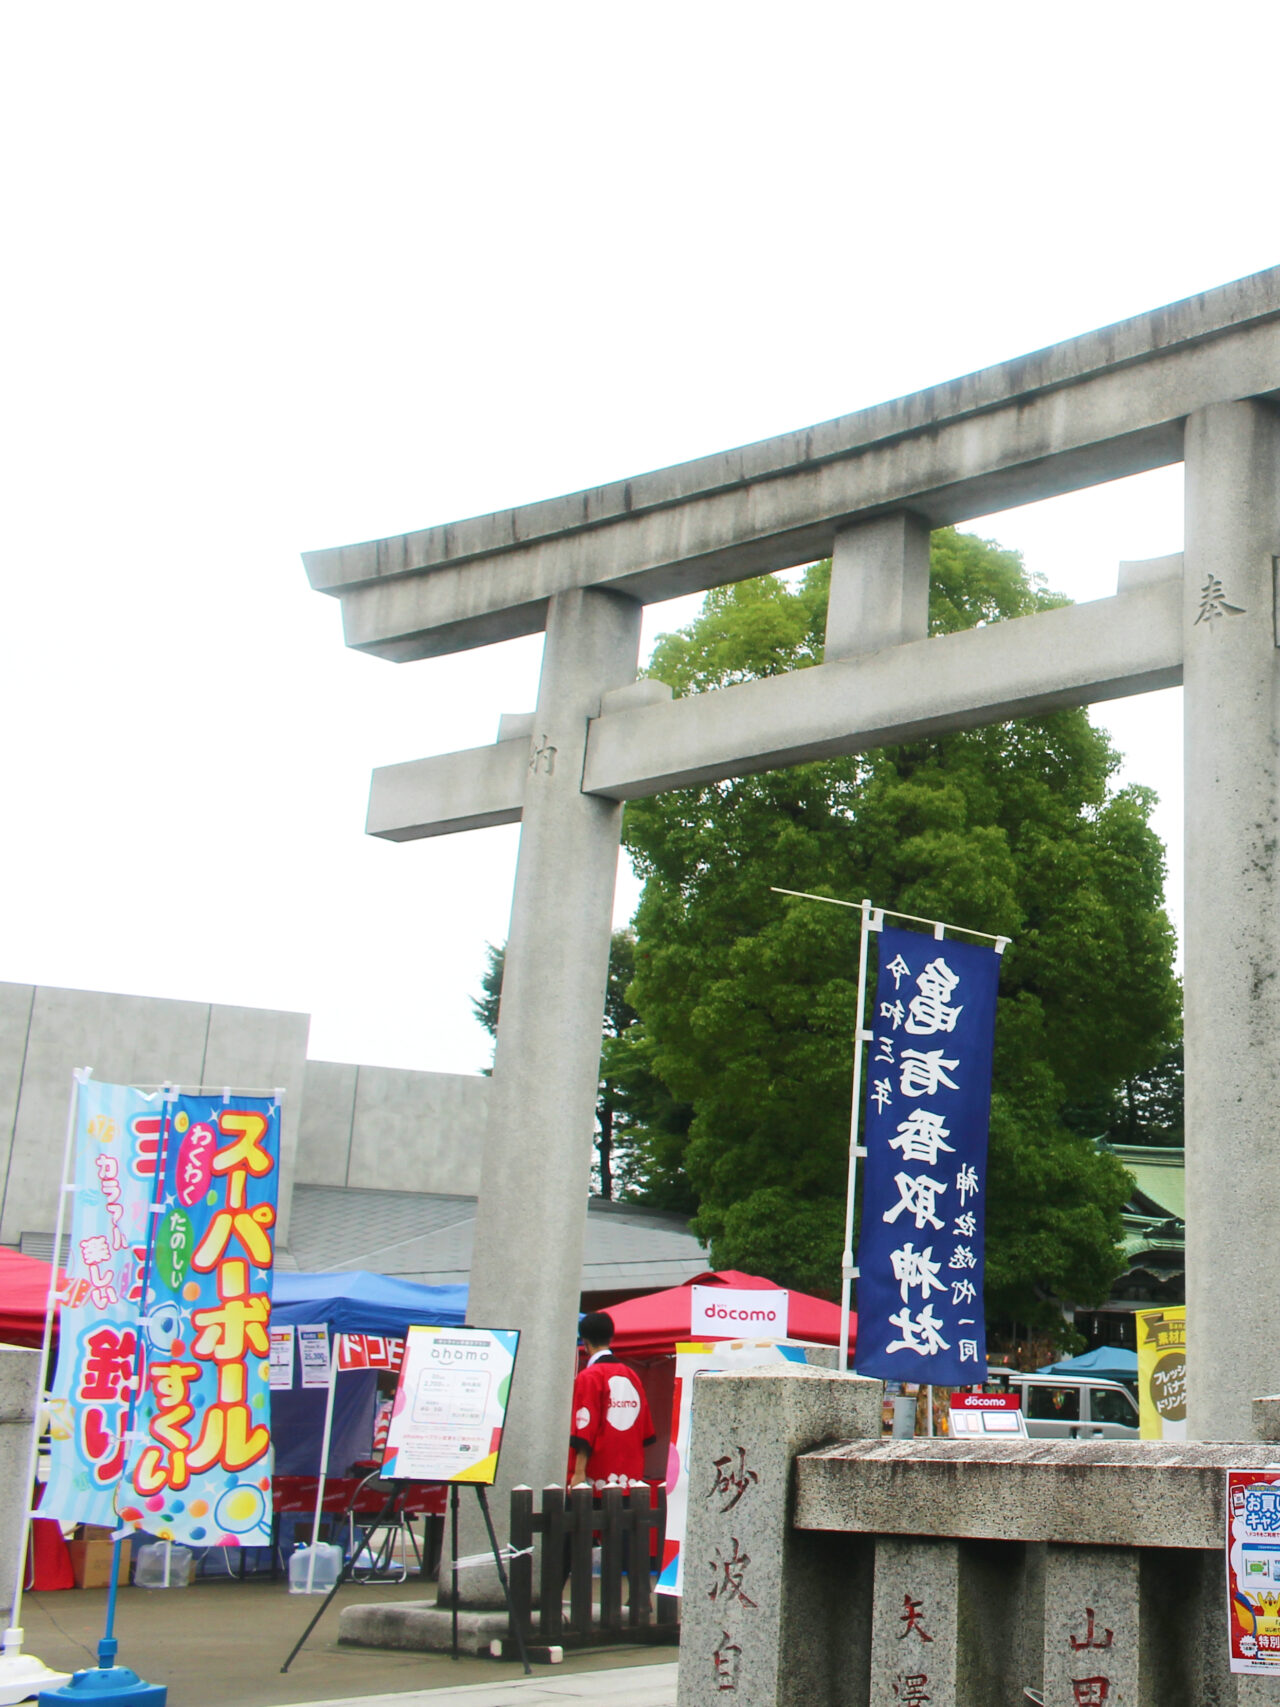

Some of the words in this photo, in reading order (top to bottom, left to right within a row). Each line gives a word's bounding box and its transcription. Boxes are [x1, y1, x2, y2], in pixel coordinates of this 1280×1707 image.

[1193, 573, 1247, 634] 奉
[182, 1125, 213, 1206] わくわく
[169, 1212, 188, 1289] たのしい
[187, 1110, 276, 1473] スーパーボール
[704, 1303, 777, 1321] docomo
[431, 1347, 490, 1361] ahamo
[133, 1361, 202, 1496] すくい
[964, 1396, 1006, 1407] docomo
[1070, 1607, 1113, 1707] 山田
